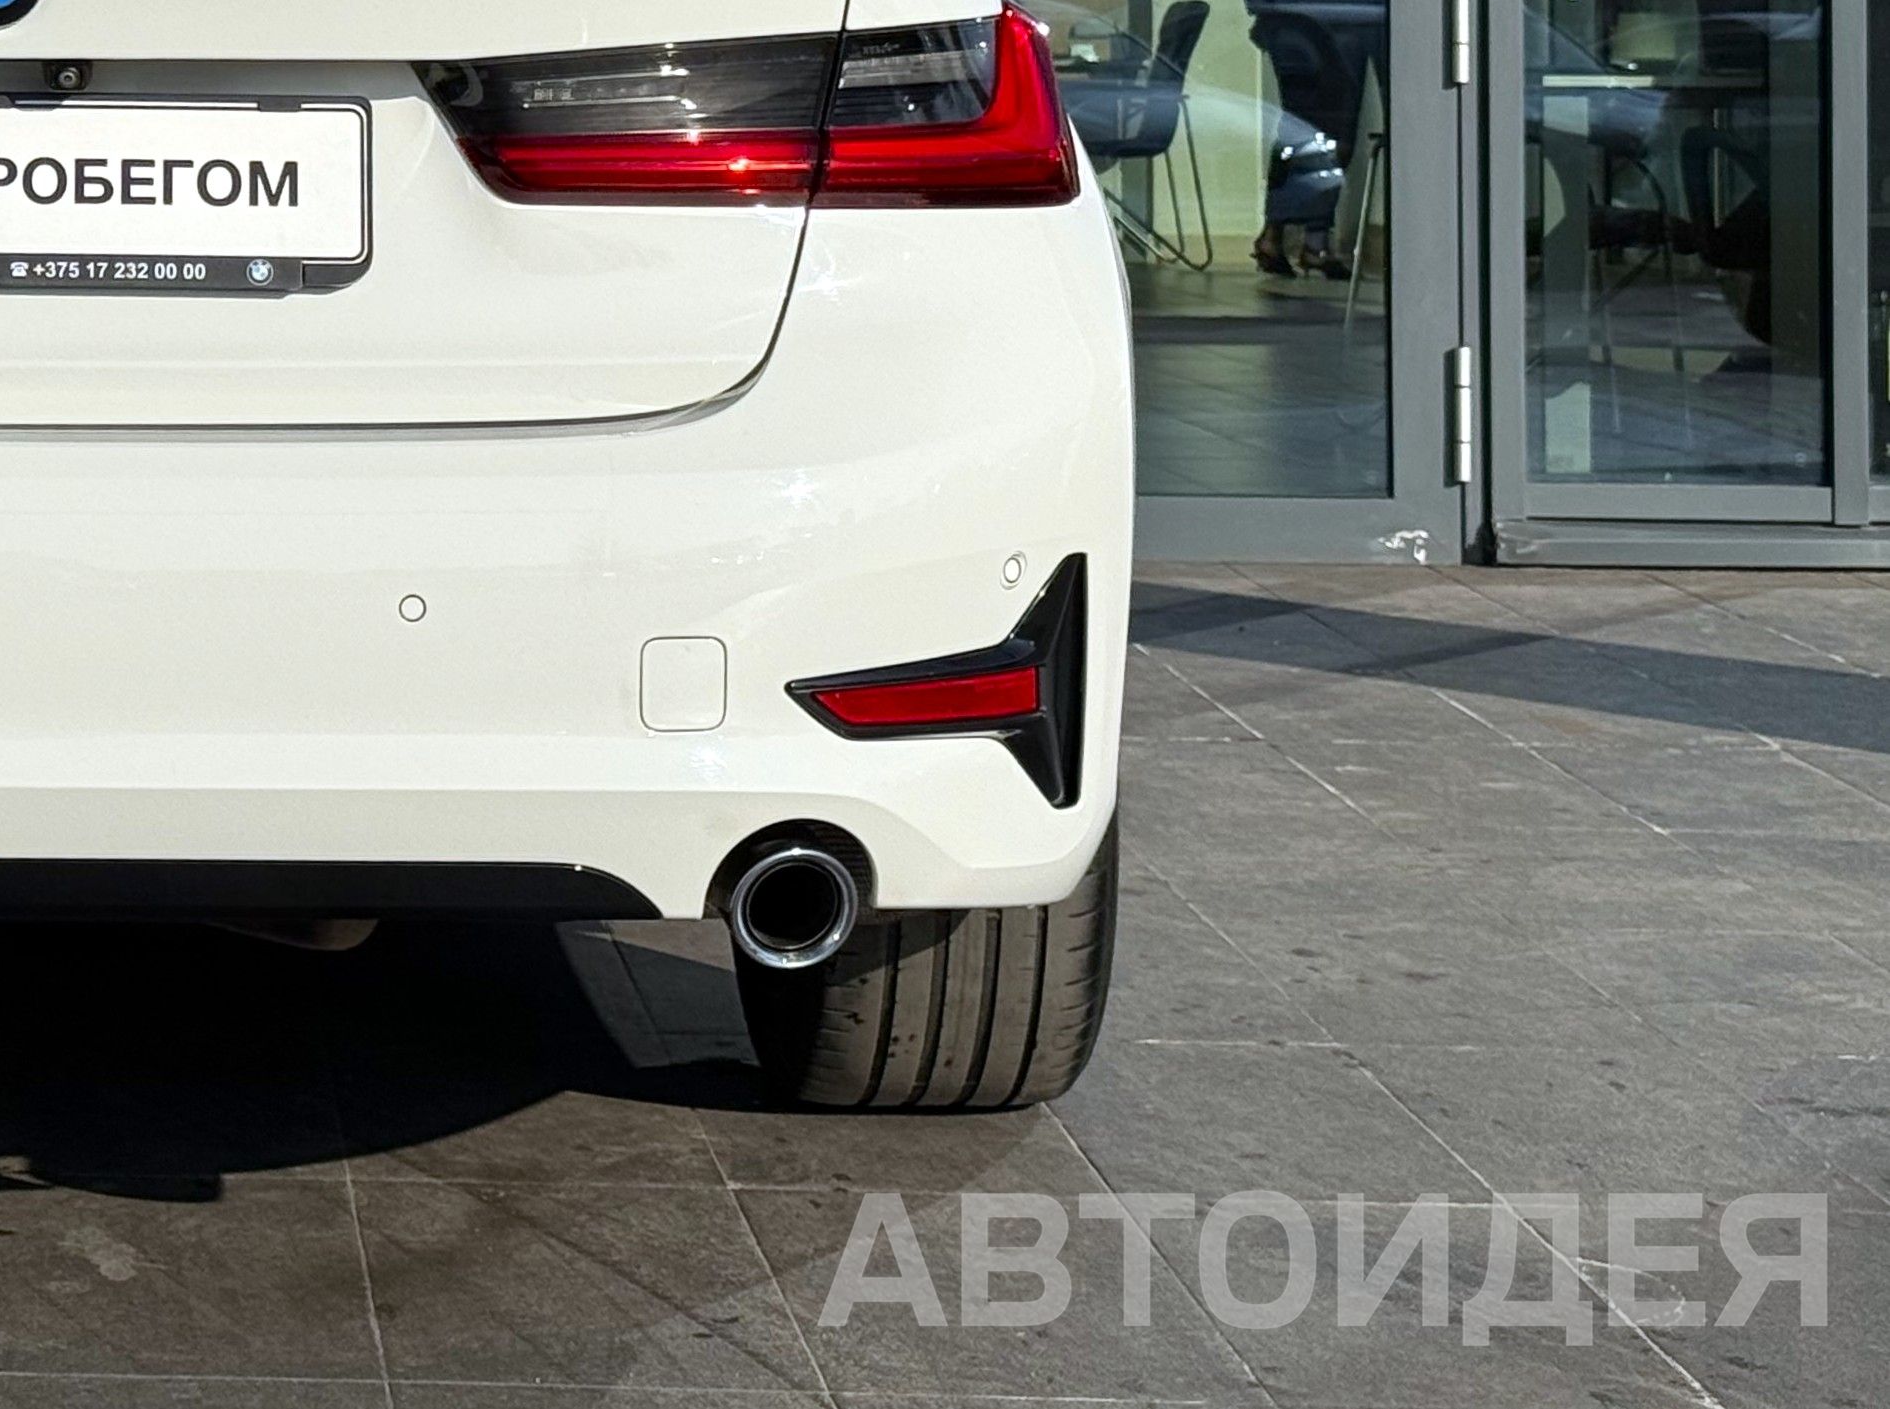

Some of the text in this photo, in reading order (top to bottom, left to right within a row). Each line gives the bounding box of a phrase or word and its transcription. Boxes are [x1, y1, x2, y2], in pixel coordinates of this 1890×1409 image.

[32, 261, 80, 280] +375
[86, 262, 107, 280] 17
[113, 262, 149, 280] 232
[154, 263, 178, 281] 00
[182, 263, 207, 281] 00
